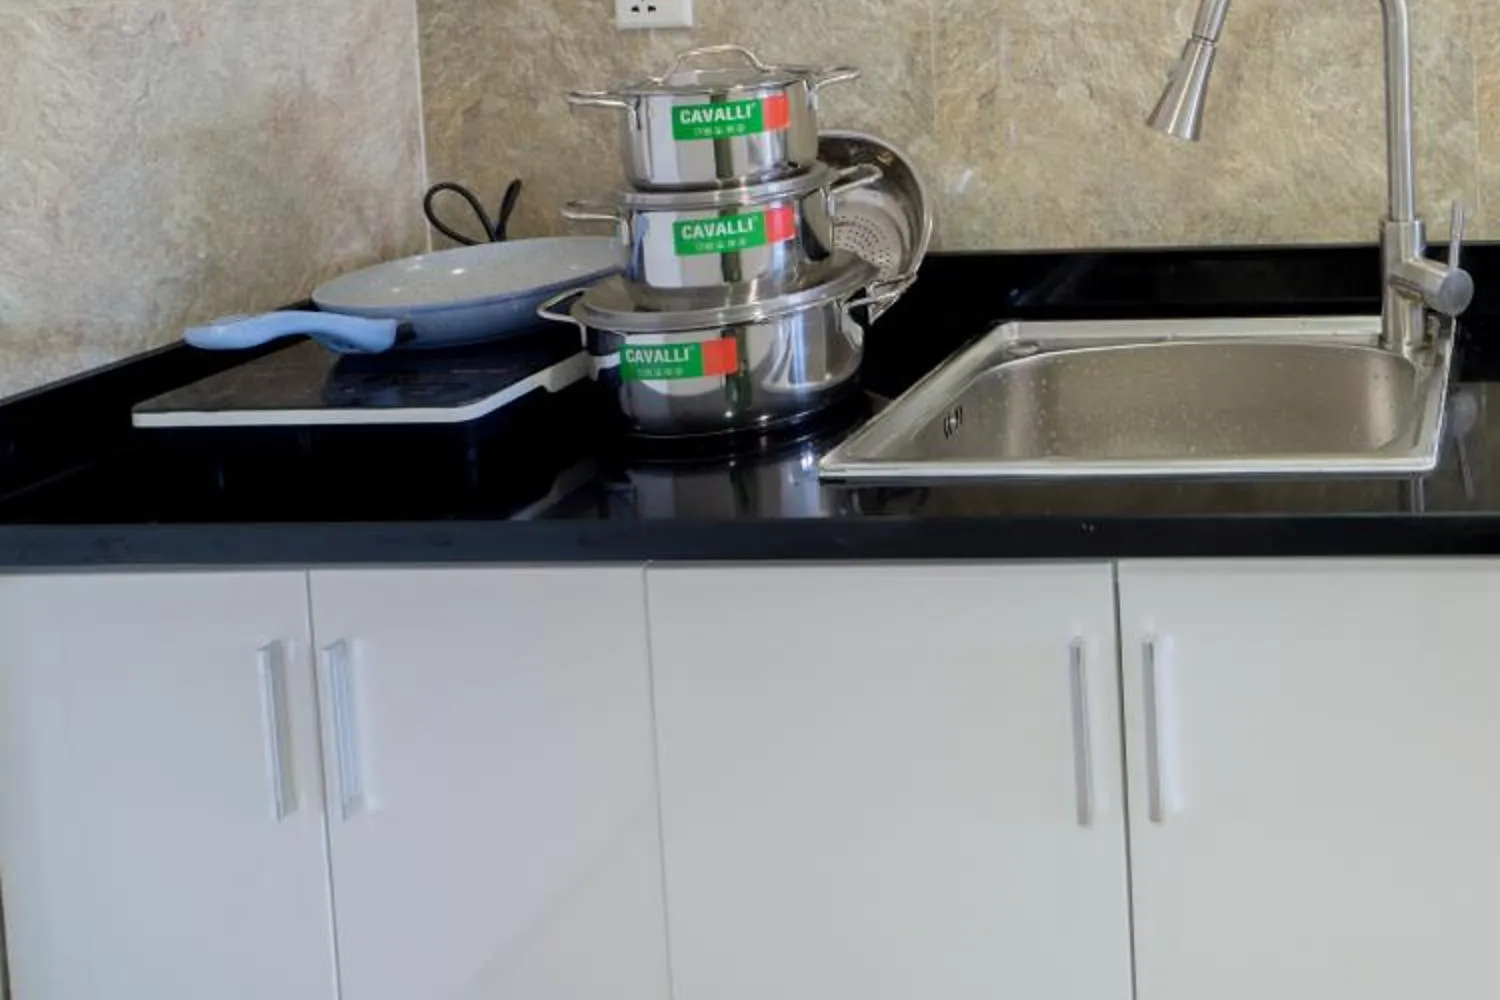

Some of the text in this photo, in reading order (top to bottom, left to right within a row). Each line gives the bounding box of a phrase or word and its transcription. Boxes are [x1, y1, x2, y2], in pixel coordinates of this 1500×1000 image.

[680, 103, 752, 125] CAVALLI
[681, 217, 754, 241] CAVALLI
[625, 347, 689, 364] CAVALLI
